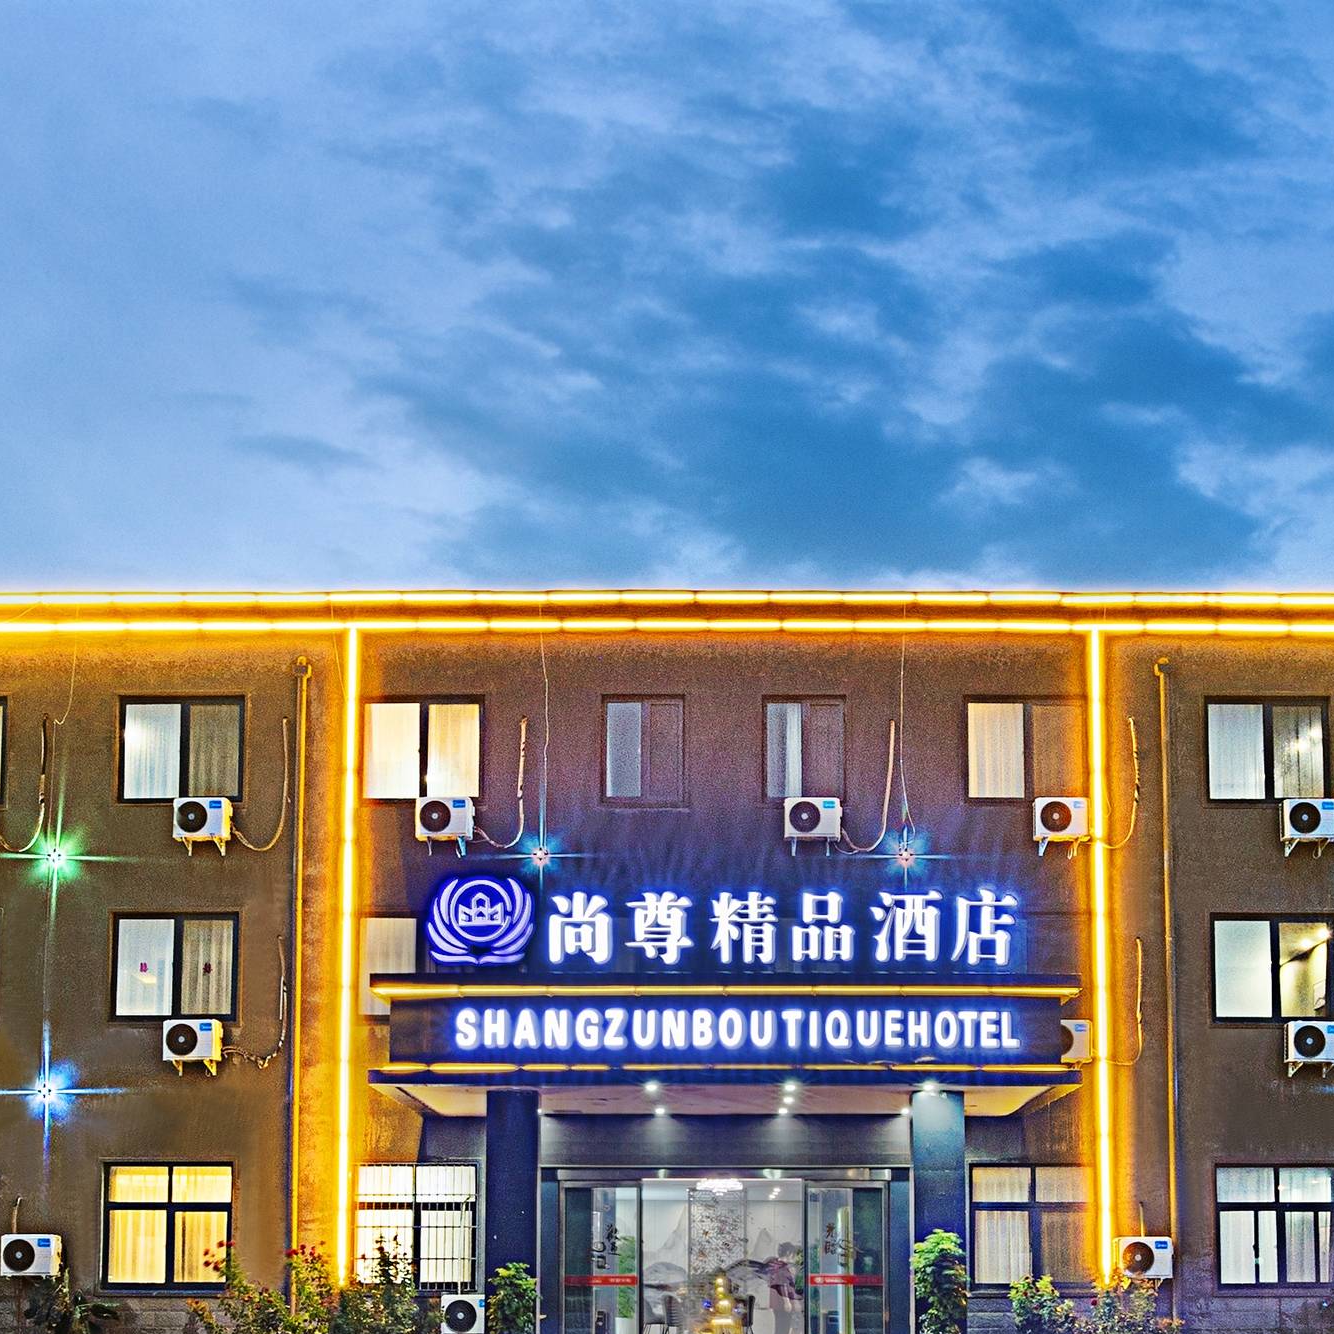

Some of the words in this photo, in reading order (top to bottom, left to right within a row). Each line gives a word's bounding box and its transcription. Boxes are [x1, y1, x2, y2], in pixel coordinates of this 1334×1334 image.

[547, 888, 1019, 965] 尚尊精品酒店
[454, 1008, 1021, 1049] SHANGZUNBOUTIQUEHOTEL
